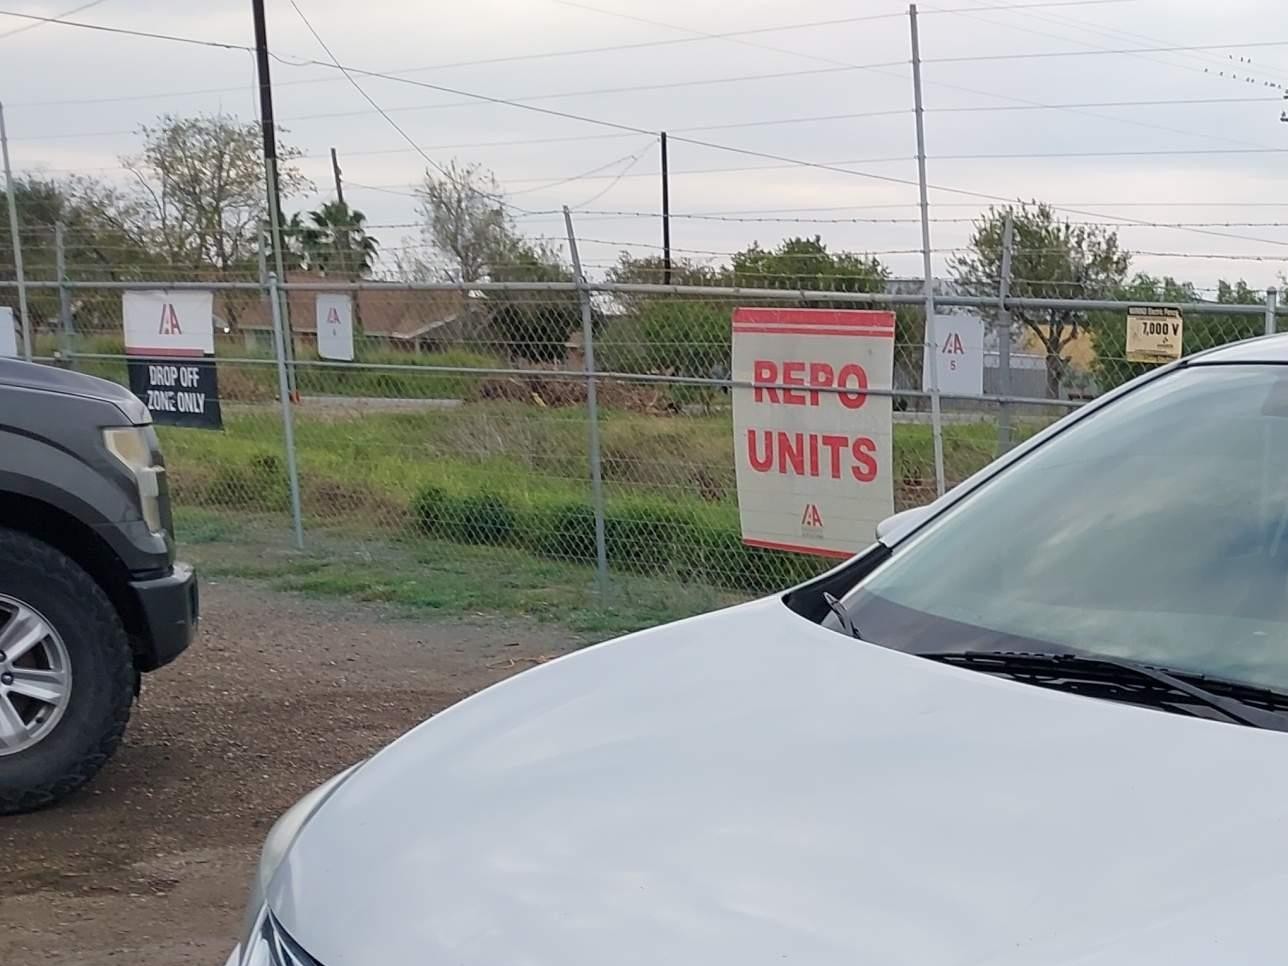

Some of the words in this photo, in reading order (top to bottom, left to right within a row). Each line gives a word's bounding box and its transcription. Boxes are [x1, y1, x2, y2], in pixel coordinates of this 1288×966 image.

[1142, 322, 1169, 336] 7,000
[1172, 323, 1179, 336] V
[149, 365, 178, 386] DROP
[180, 366, 200, 388] OFF
[754, 360, 868, 410] REPO
[147, 390, 177, 412] ZONE
[177, 391, 205, 413] ONLY
[747, 429, 878, 482] UNITS
